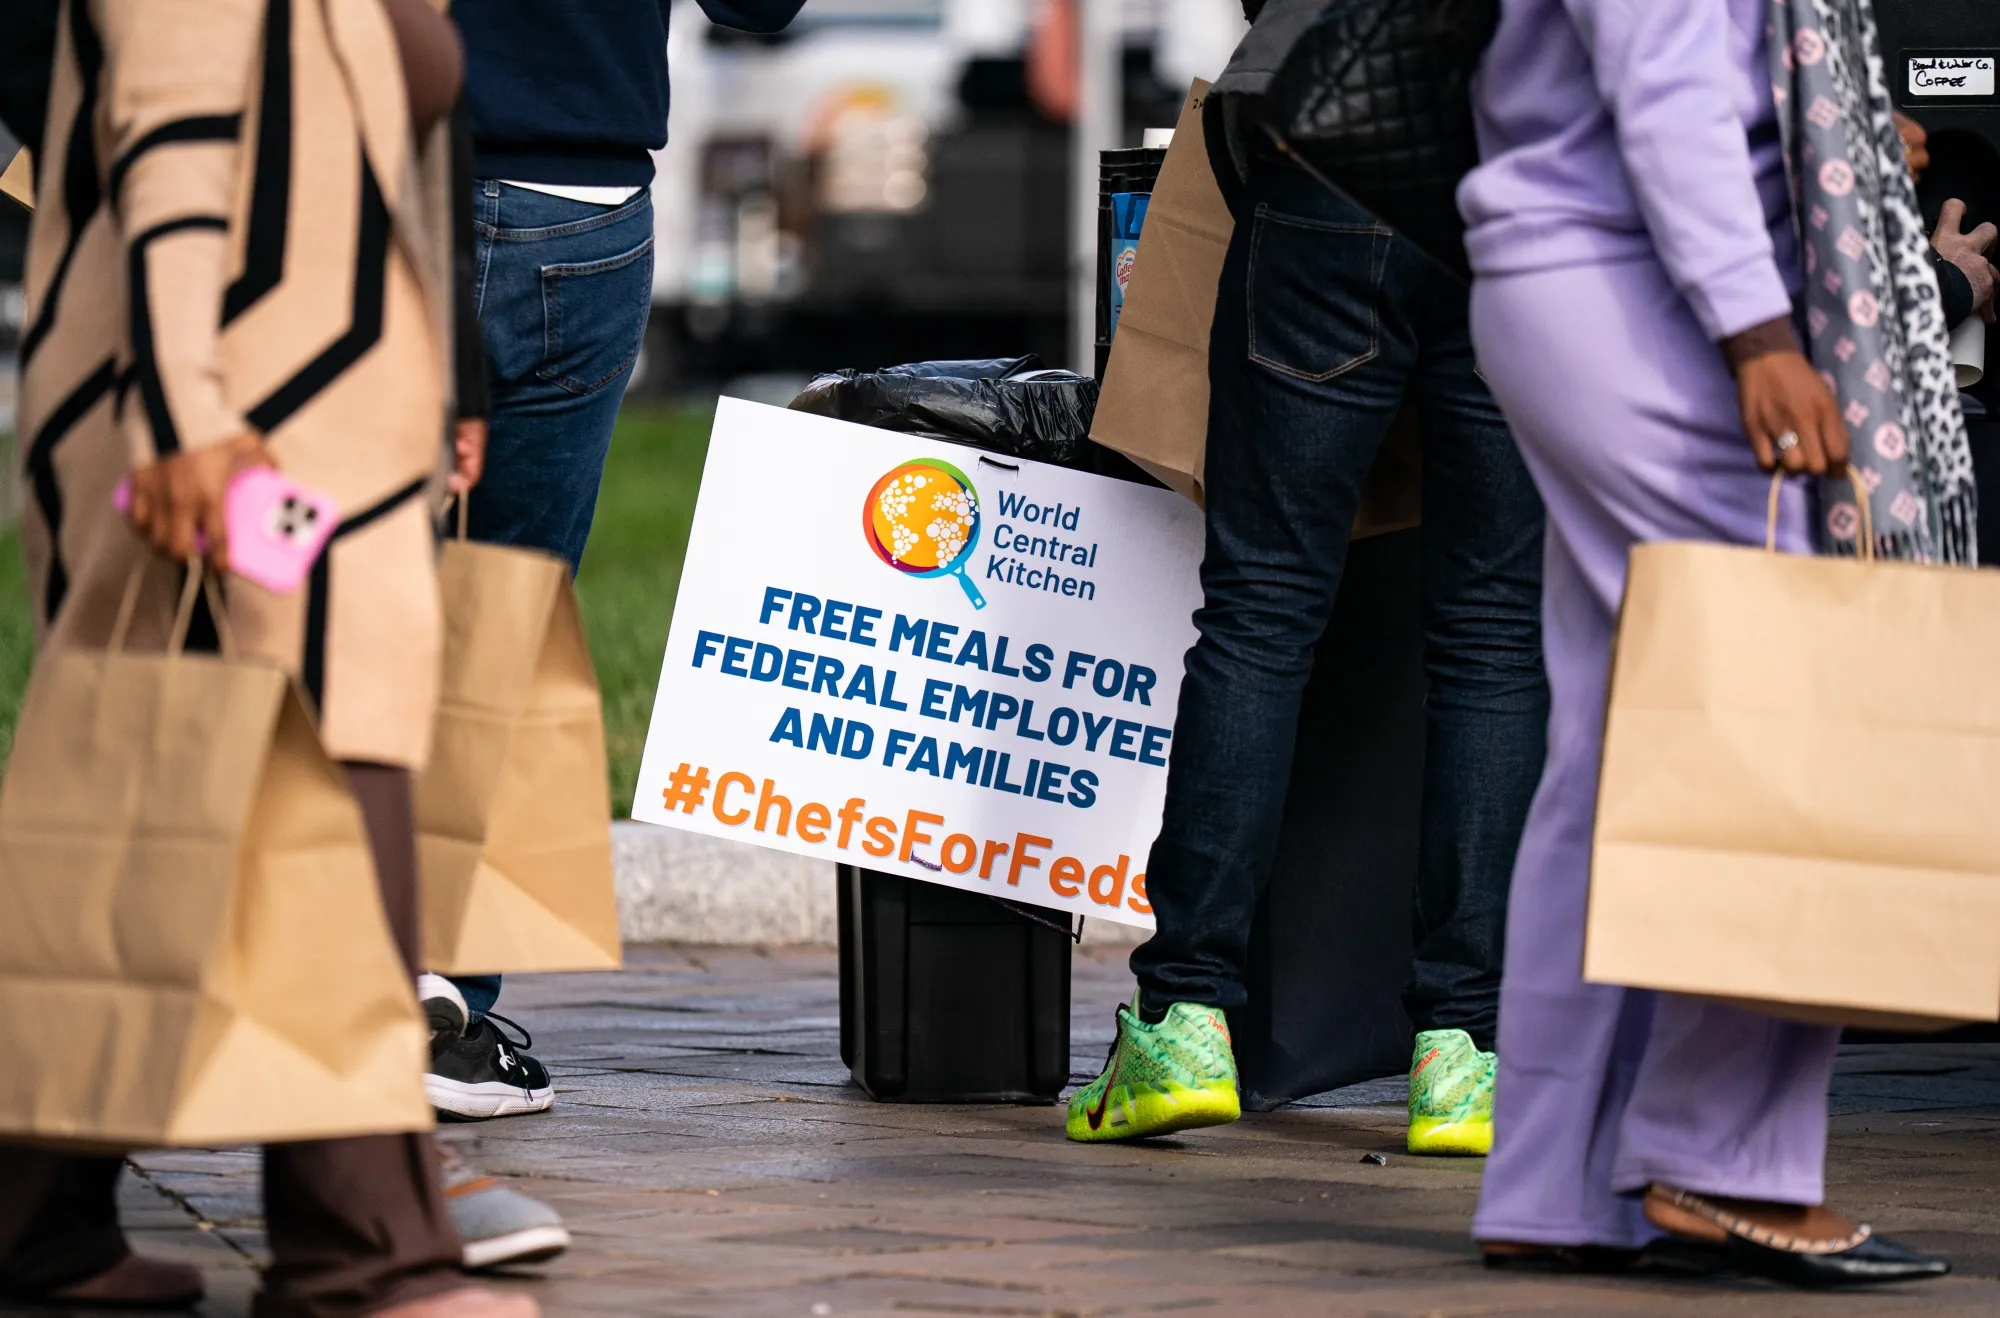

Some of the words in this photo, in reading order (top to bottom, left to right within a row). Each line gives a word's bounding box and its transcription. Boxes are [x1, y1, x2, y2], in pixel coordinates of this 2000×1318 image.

[1975, 59, 1992, 70] Co.
[993, 524, 1098, 568] Central
[999, 490, 1080, 532] World
[986, 554, 1095, 601] Kitchen
[759, 586, 883, 647] FREE
[889, 613, 1054, 683] MEALS
[1062, 649, 1157, 706] FOR
[691, 630, 908, 712] FEDERAL
[919, 678, 1173, 767] EMPLOYEE
[769, 707, 875, 760] AND
[882, 728, 1100, 809] FAMILIES
[662, 762, 1154, 915] #ChefsForFeds
